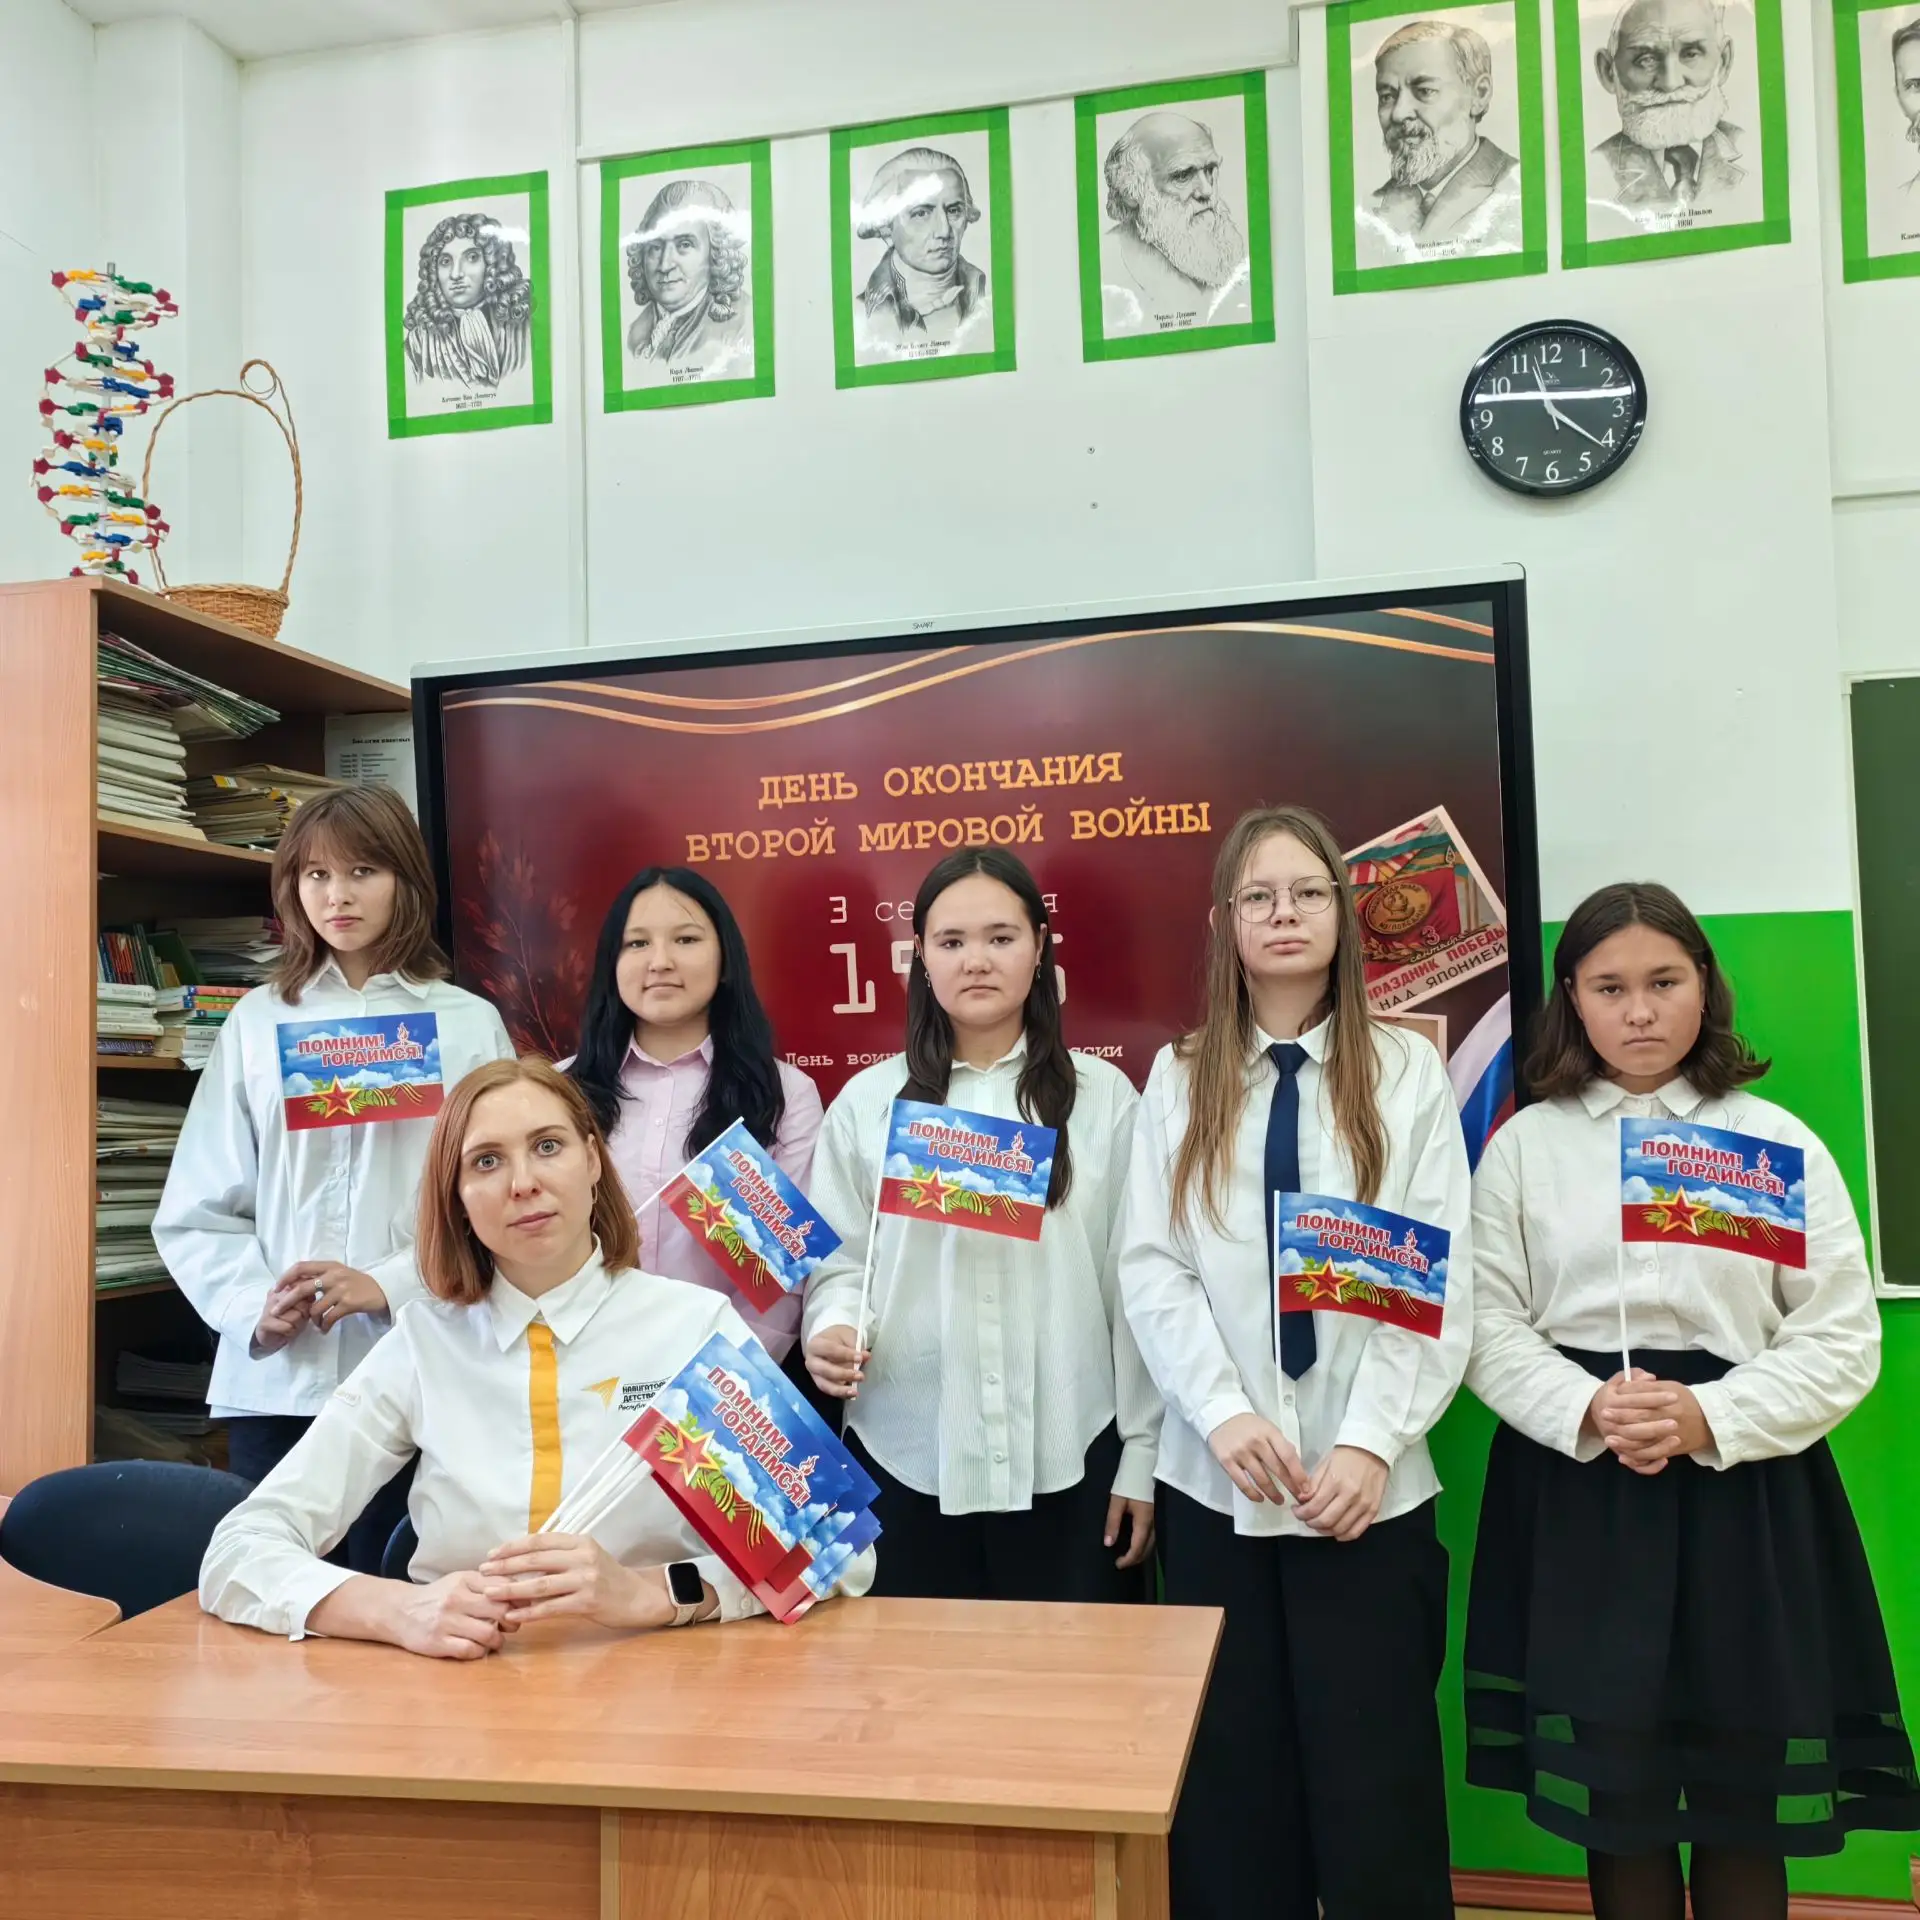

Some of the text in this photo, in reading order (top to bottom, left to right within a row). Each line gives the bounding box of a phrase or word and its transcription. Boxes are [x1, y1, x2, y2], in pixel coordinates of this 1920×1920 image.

[1511, 353, 1529, 375] 11
[1540, 343, 1563, 365] 12
[1579, 347, 1588, 368] 1
[1491, 376, 1511, 396] 10
[1600, 367, 1614, 388] 2
[1612, 397, 1625, 418] 3
[1480, 409, 1493, 430] 9
[1491, 436, 1504, 456] 8
[1601, 428, 1615, 448] 4
[1515, 456, 1528, 477] 7
[1545, 460, 1559, 481] 6
[1579, 451, 1591, 472] 5
[757, 752, 1124, 812] ДЕНЬ ОКОНЧАНИЯ
[685, 797, 1212, 863] ВТОРОЙ МИРОВОЙ ВОЙНЫ
[1421, 925, 1440, 946] 3
[1379, 941, 1507, 1011] НАД ЯПОНИЕЙ
[297, 1034, 385, 1054] ПОМНИМ!
[321, 1045, 424, 1067] ГОРДИМСЯ!
[785, 1052, 834, 1067] День
[908, 1121, 1000, 1151] ПОМНИМ!
[927, 1140, 1035, 1176] ГОРДИМСЯ!
[1640, 1139, 1743, 1170] ПОМНИМ!
[728, 1148, 794, 1221] ПОМНИМ!
[1666, 1158, 1785, 1197] ГОРДИМСЯ!
[731, 1176, 807, 1261] ГОРДИМСЯ!
[1296, 1214, 1391, 1245] ПОМНИМ!
[1317, 1231, 1430, 1274] ГОРДИМСЯ!
[706, 1365, 794, 1458] ПОМНИМ!
[712, 1400, 812, 1509] ГОРДИМСЯ!
